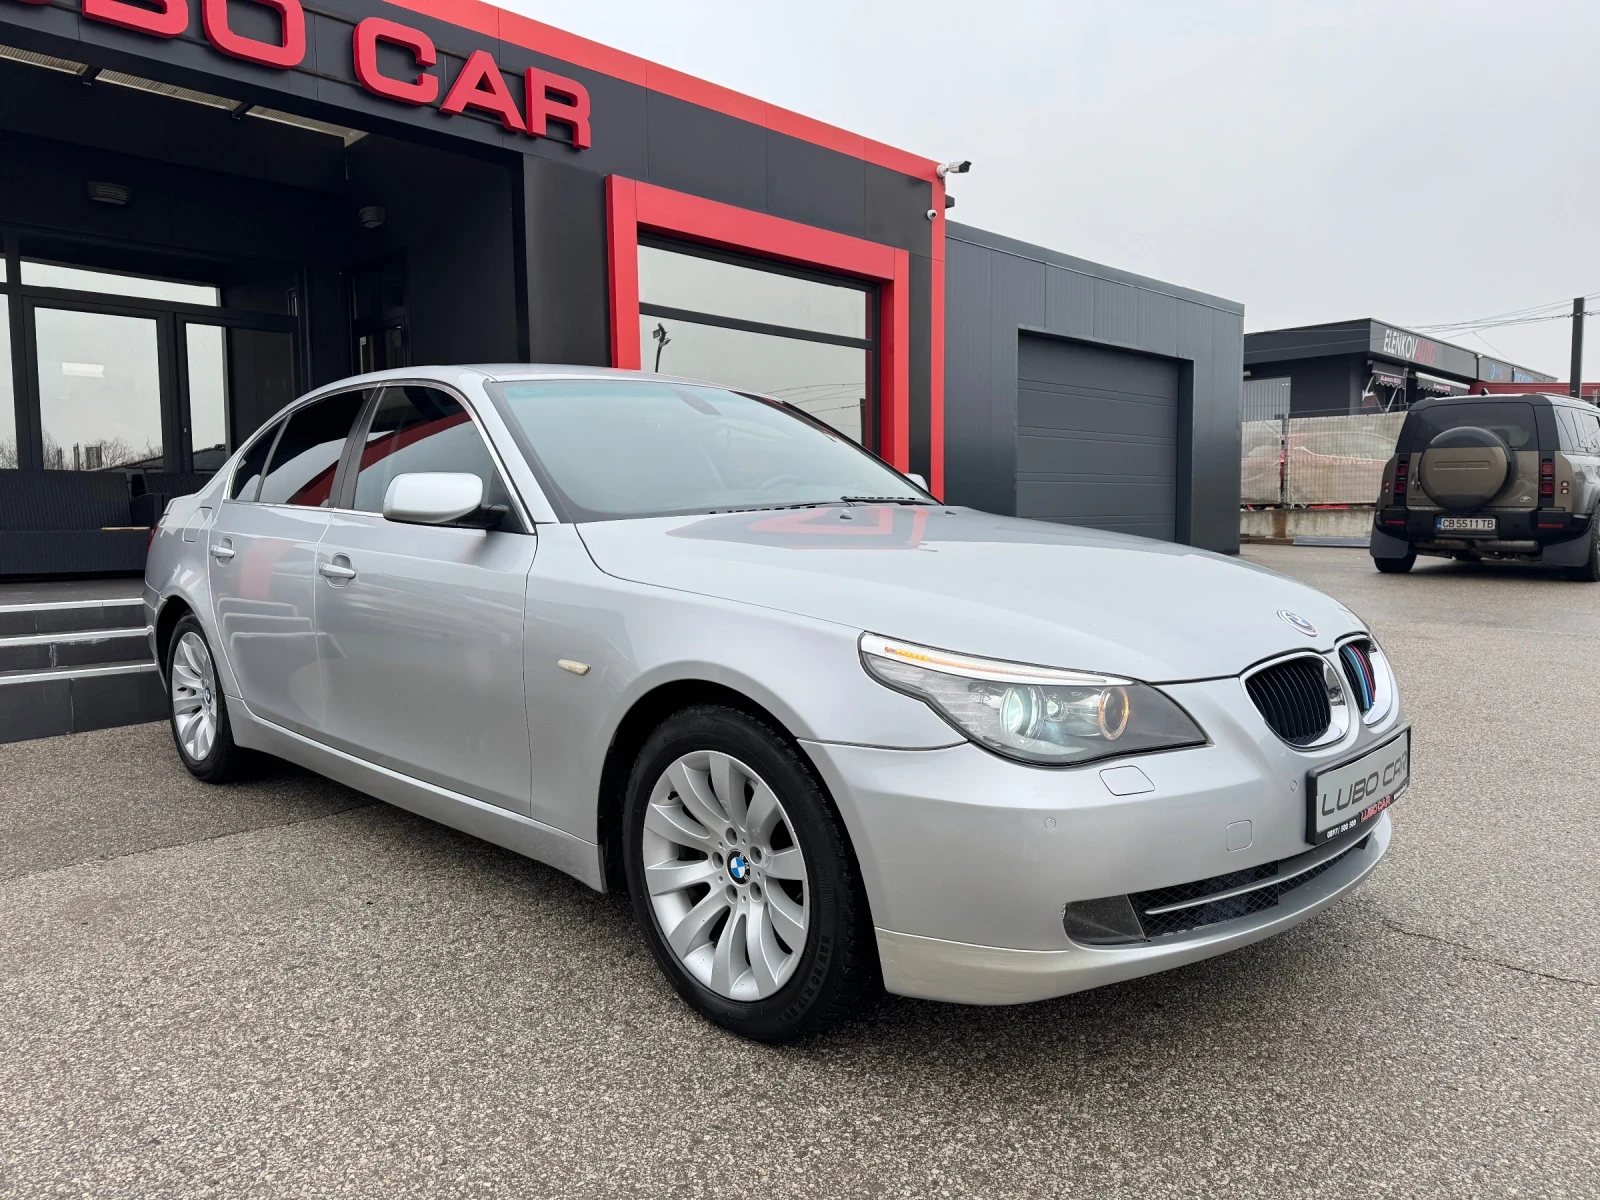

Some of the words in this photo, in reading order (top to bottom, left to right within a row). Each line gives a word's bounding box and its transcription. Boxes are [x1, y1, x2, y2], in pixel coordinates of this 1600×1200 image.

[353, 17, 591, 150] CAR
[1442, 519, 1455, 528] CB
[1456, 519, 1479, 529] 5511
[1481, 519, 1494, 529] TB
[1322, 771, 1379, 816] LUBO
[1382, 750, 1407, 787] CAR
